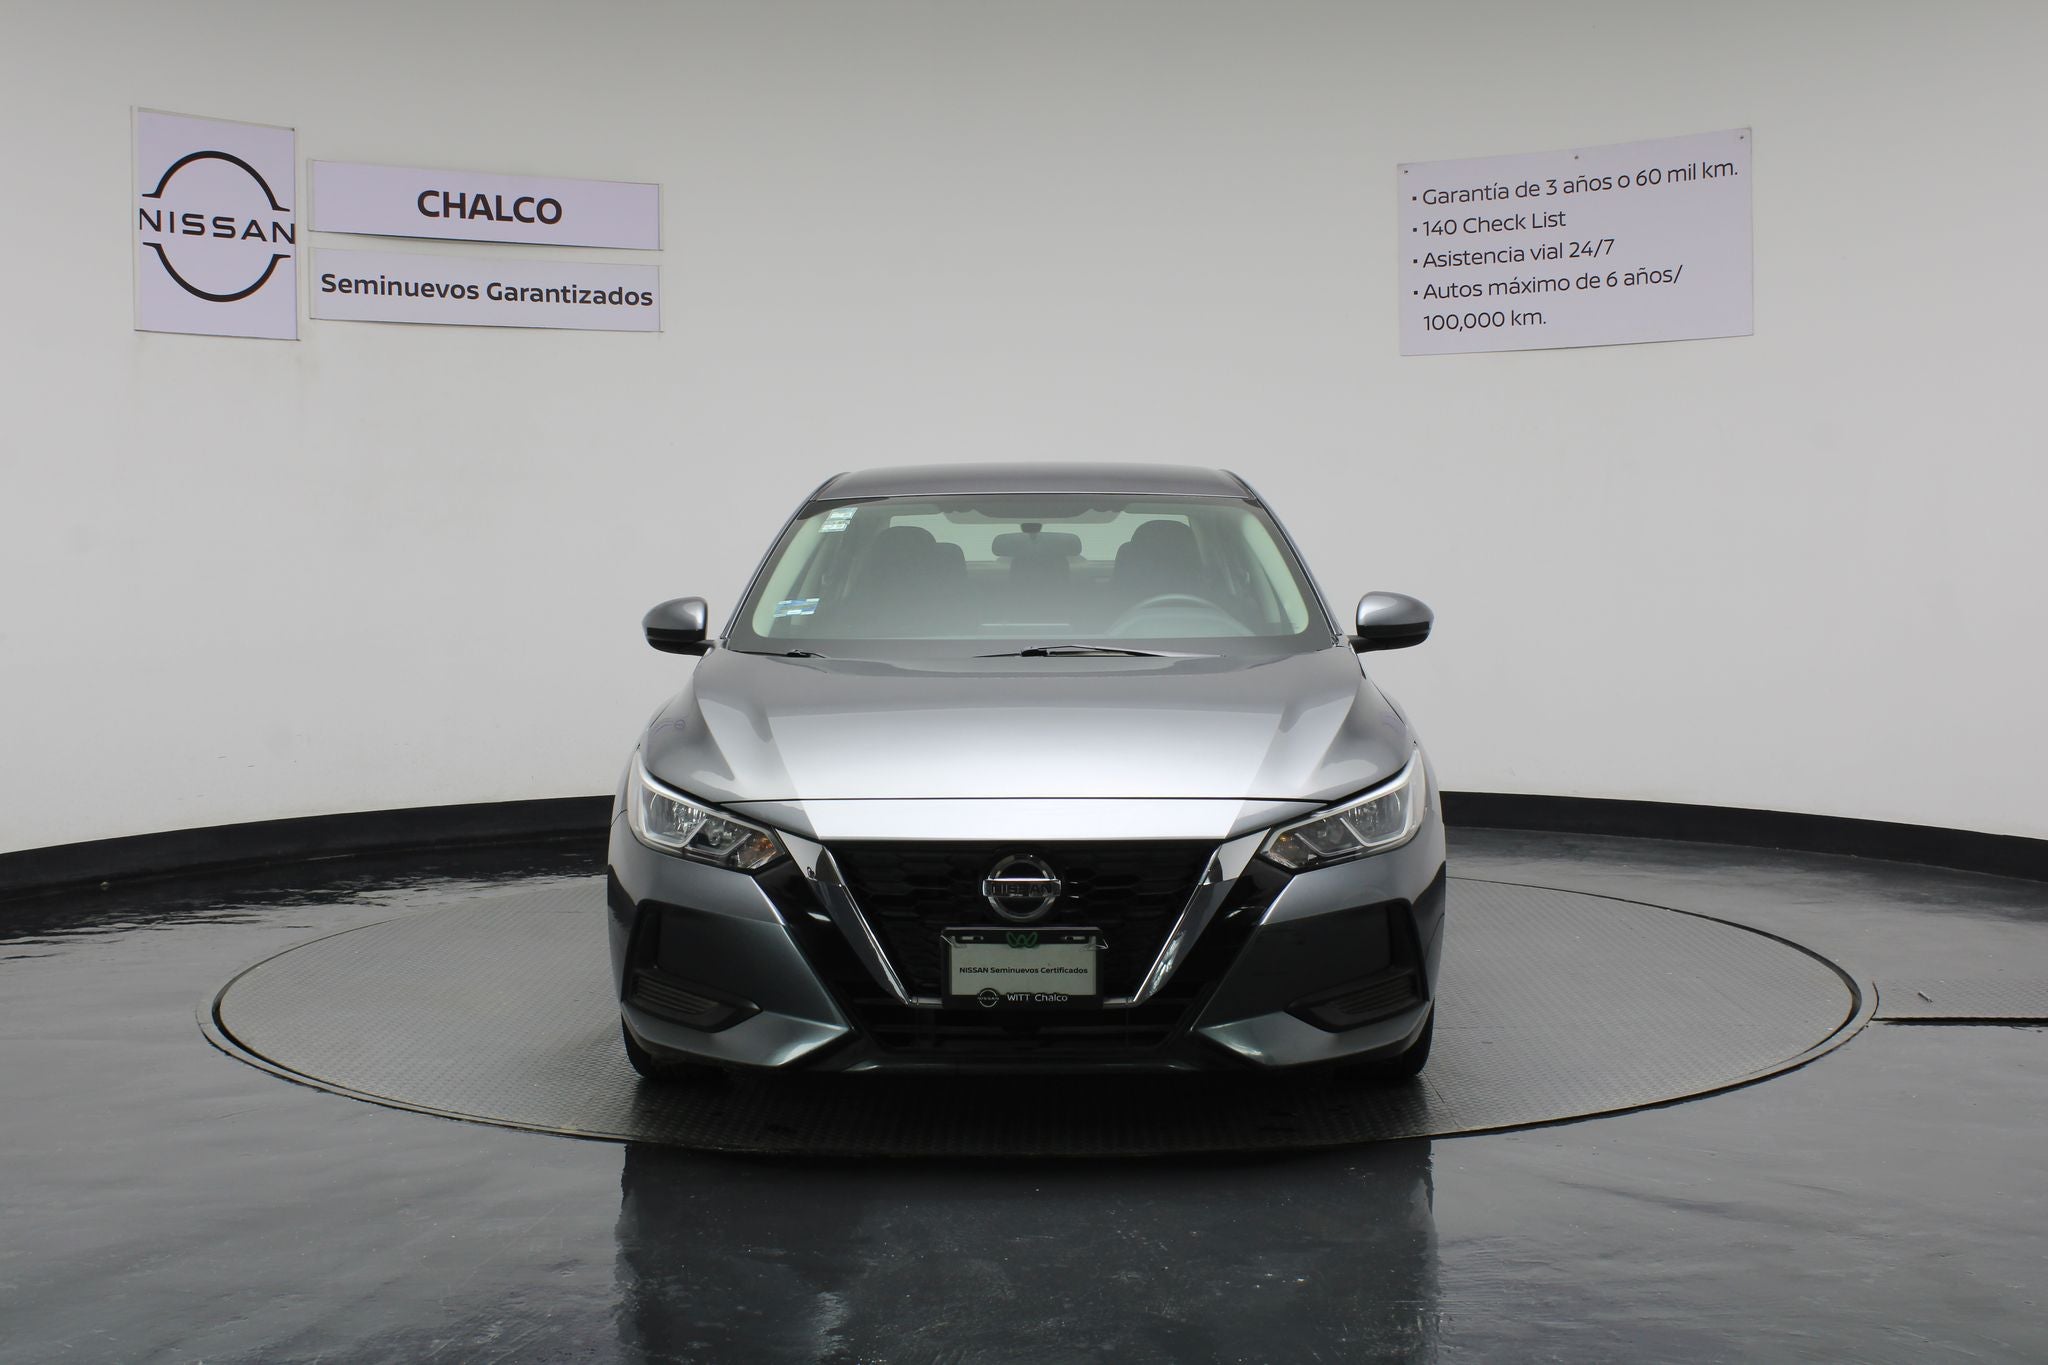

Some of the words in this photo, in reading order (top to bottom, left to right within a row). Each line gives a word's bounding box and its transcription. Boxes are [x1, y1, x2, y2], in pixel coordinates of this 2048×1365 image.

[1422, 182, 1510, 206] Garantía
[1514, 180, 1541, 199] de
[1545, 178, 1558, 196] 3
[1563, 174, 1613, 195] años
[1617, 174, 1631, 189] o
[1635, 167, 1662, 187] 60
[1667, 162, 1697, 184] mil
[1702, 161, 1738, 180] km.
[417, 190, 563, 225] CHALCO
[1422, 218, 1458, 237] 140
[1463, 213, 1527, 234] Check
[1532, 210, 1567, 229] List
[138, 207, 296, 245] NISSAN
[1422, 246, 1525, 269] Asistencia
[1530, 242, 1563, 261] vial
[1568, 238, 1616, 259] 24/7
[321, 273, 480, 301] Seminuevos
[486, 281, 654, 307] Garantizados
[1422, 282, 1483, 301] Autos
[1488, 276, 1571, 297] máximo
[1575, 272, 1601, 290] de
[1606, 271, 1618, 288] 6
[1623, 264, 1684, 287] años/
[1423, 311, 1506, 333] 100,000
[1511, 309, 1547, 327] km.
[1040, 966, 1088, 974] Certificados
[1007, 994, 1030, 1002] WITT
[1035, 994, 1068, 1002] Chalco
